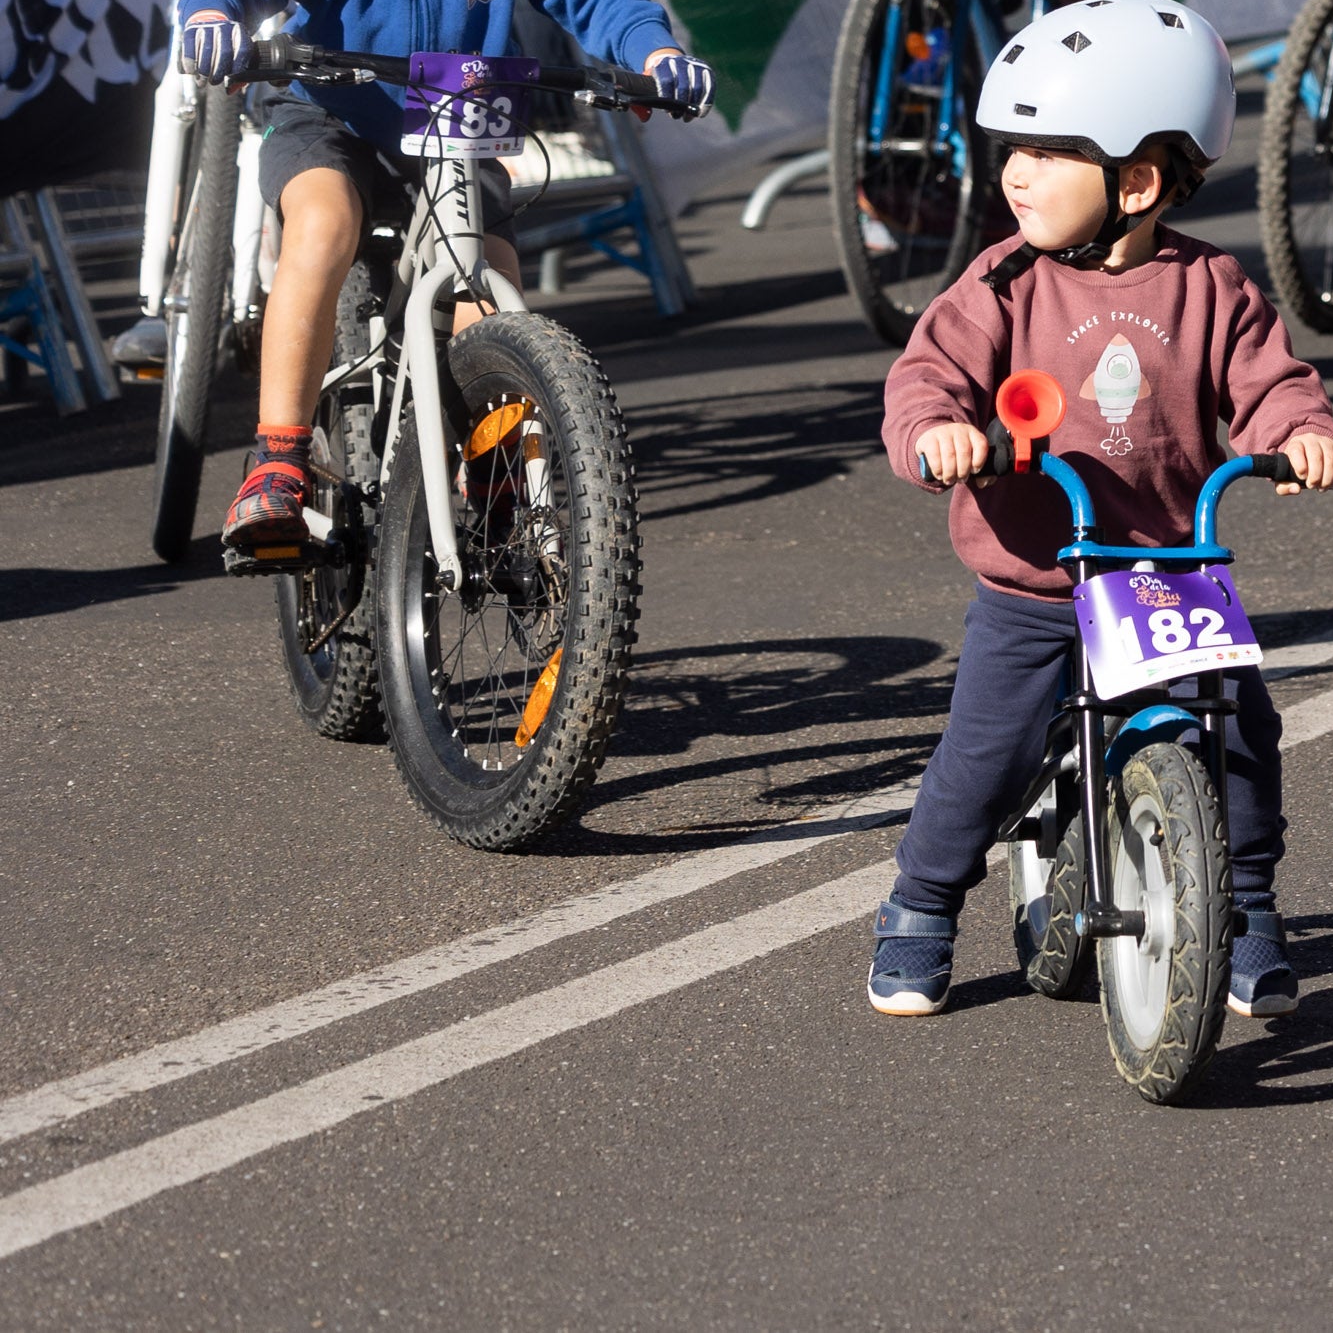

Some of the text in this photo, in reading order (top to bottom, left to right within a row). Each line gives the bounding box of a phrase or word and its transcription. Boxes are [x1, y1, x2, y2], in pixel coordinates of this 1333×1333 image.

[431, 95, 513, 138] 183
[1067, 315, 1099, 345] SPACE
[1117, 607, 1235, 664] 182
